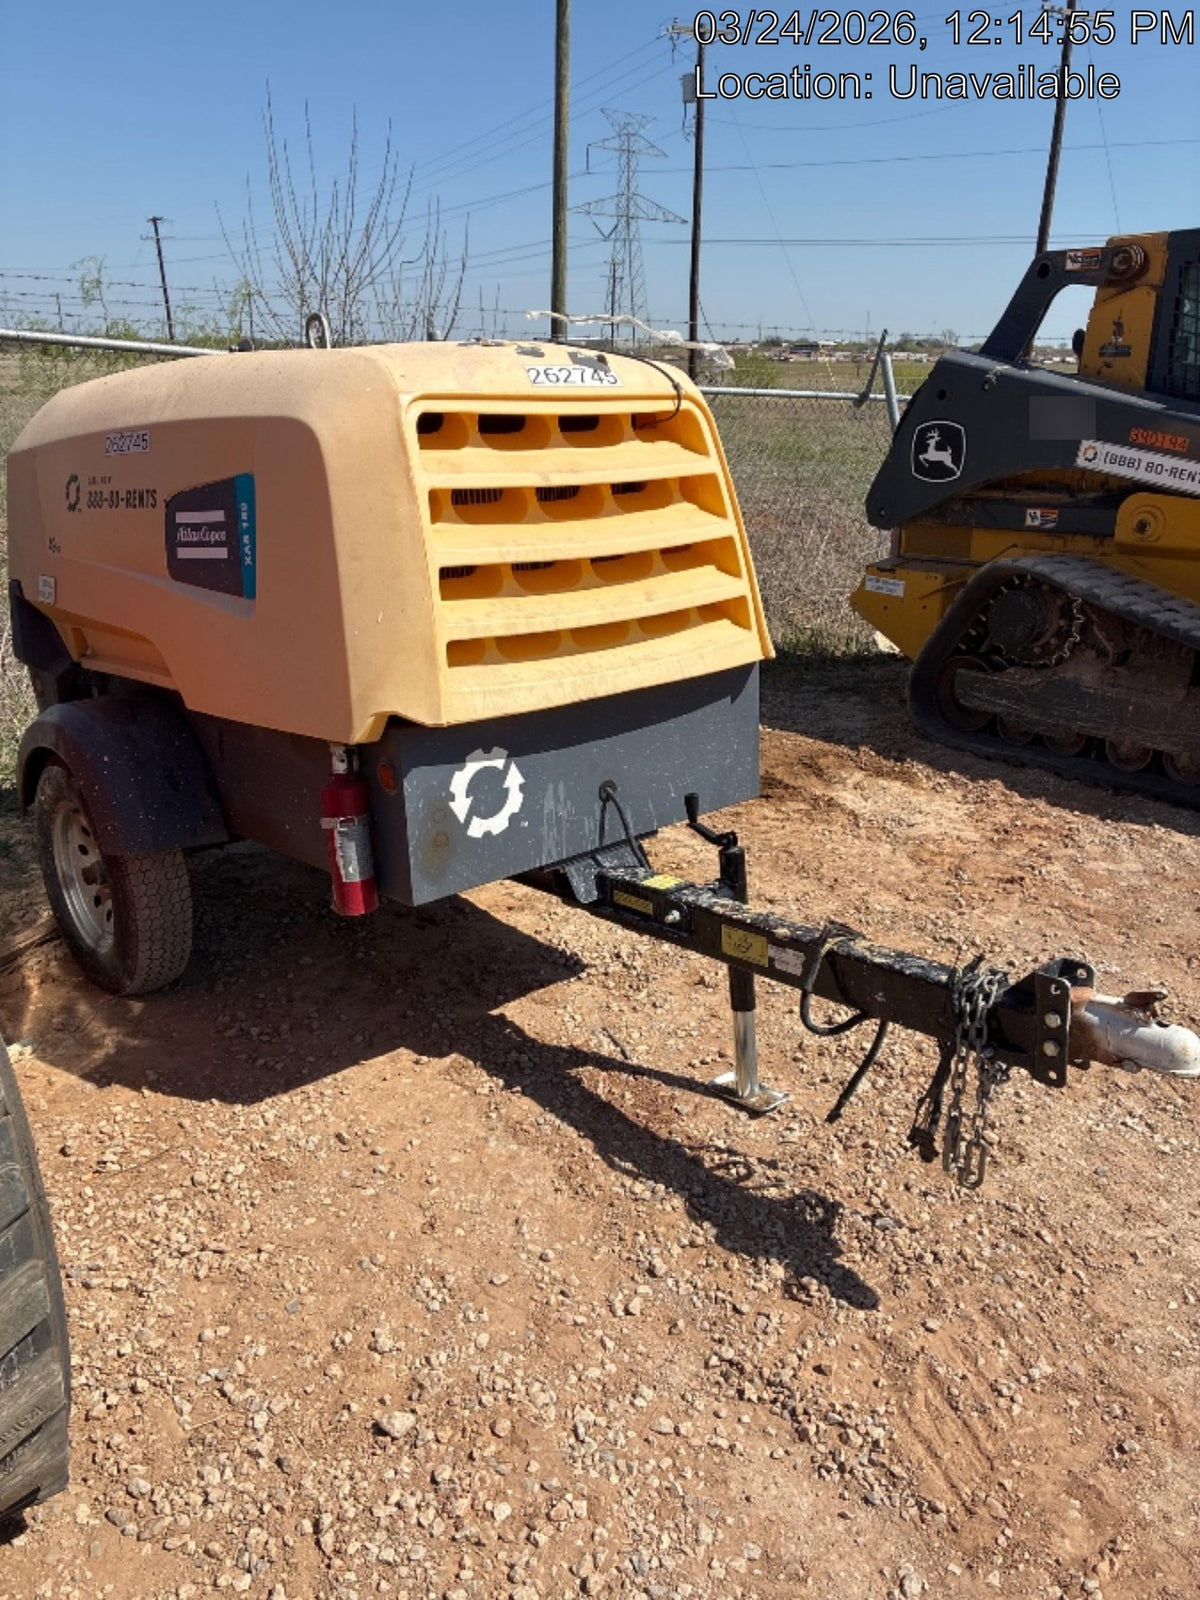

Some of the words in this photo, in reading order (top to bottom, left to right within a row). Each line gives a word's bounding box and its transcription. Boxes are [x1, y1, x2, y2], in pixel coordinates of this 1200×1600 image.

[527, 367, 618, 385] 262745
[105, 433, 148, 453] 262745
[1103, 451, 1142, 471] (888)
[87, 488, 157, 509] 888-80-RENTS
